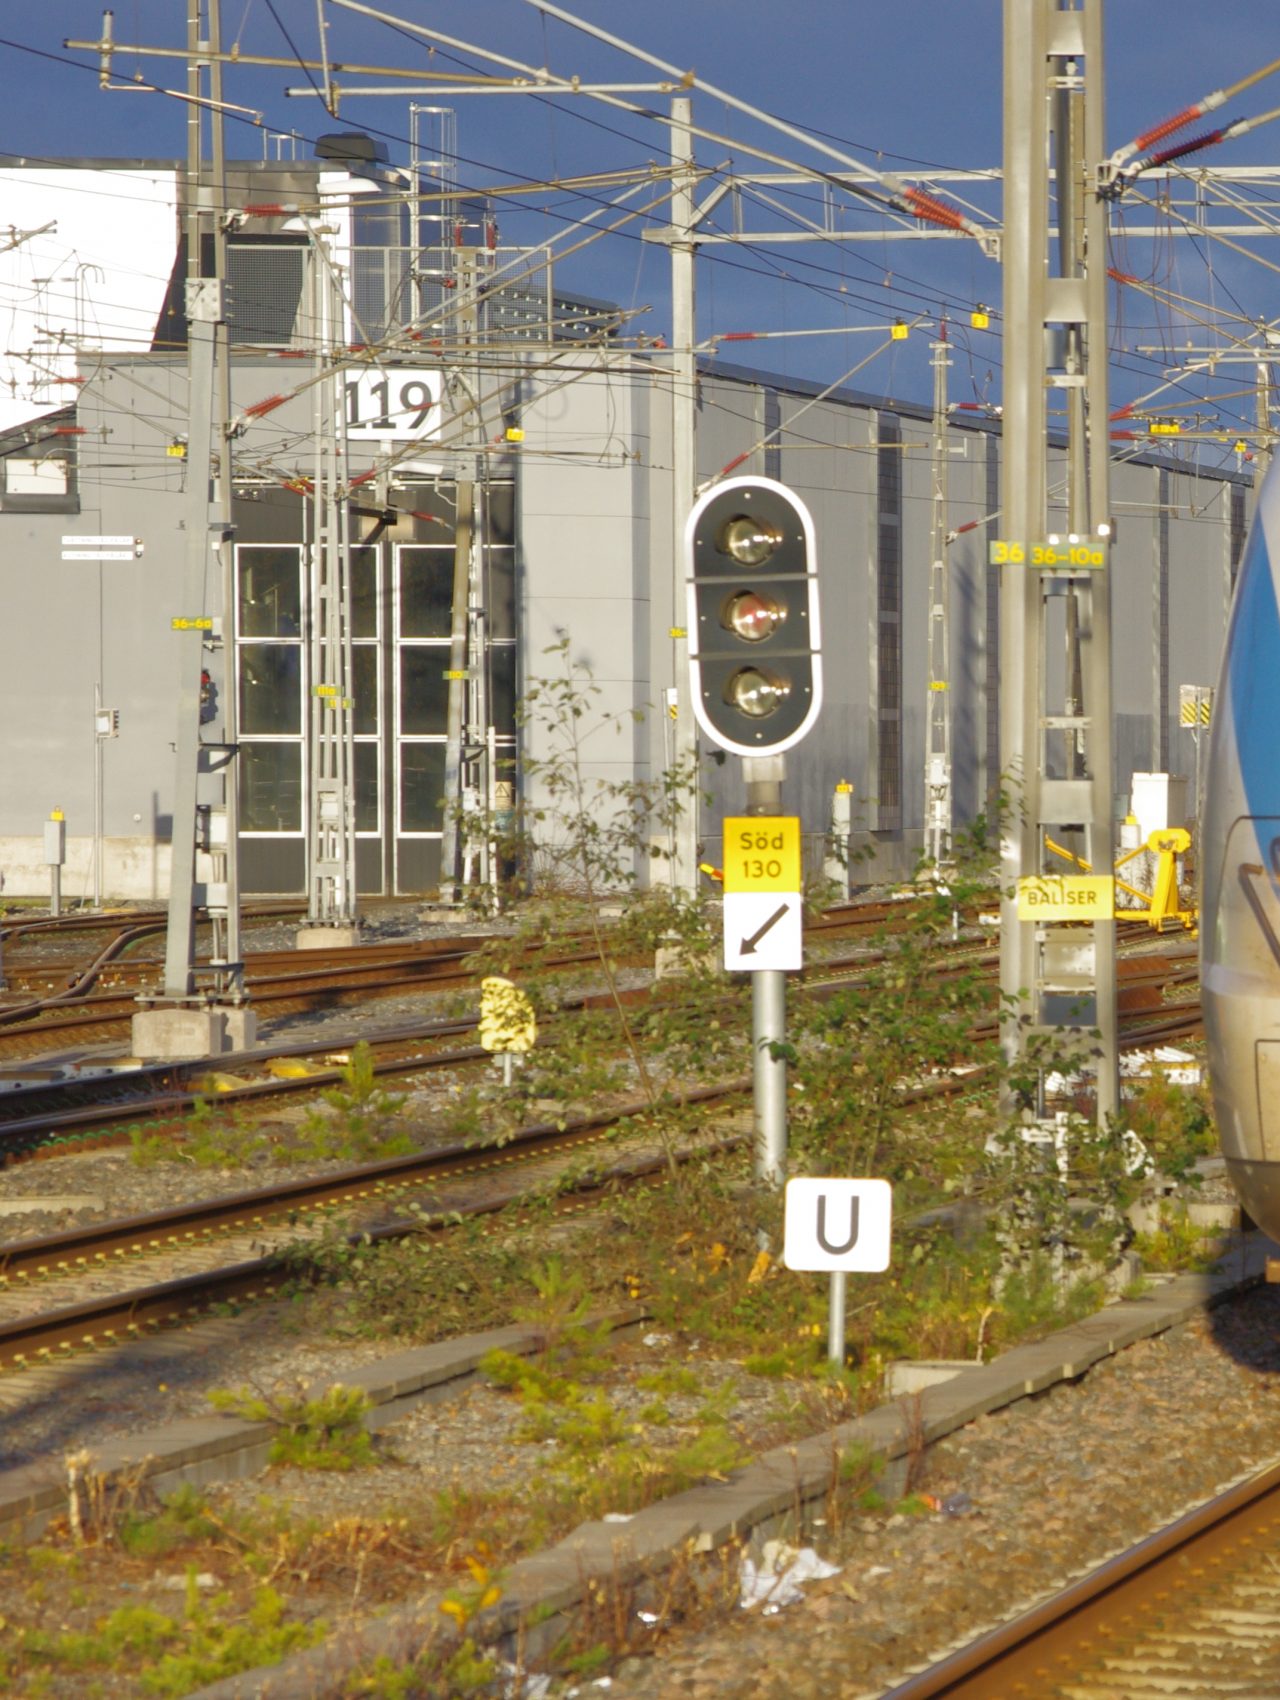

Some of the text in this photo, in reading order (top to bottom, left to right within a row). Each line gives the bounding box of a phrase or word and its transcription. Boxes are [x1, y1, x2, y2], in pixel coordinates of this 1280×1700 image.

[346, 380, 433, 429] 119
[994, 543, 1025, 562] 36
[1031, 547, 1104, 565] 36-10a
[172, 618, 212, 630] 36-6a
[669, 627, 688, 637] 36-
[740, 832, 784, 850] Söd
[743, 860, 782, 878] 130
[815, 1195, 860, 1255] U
